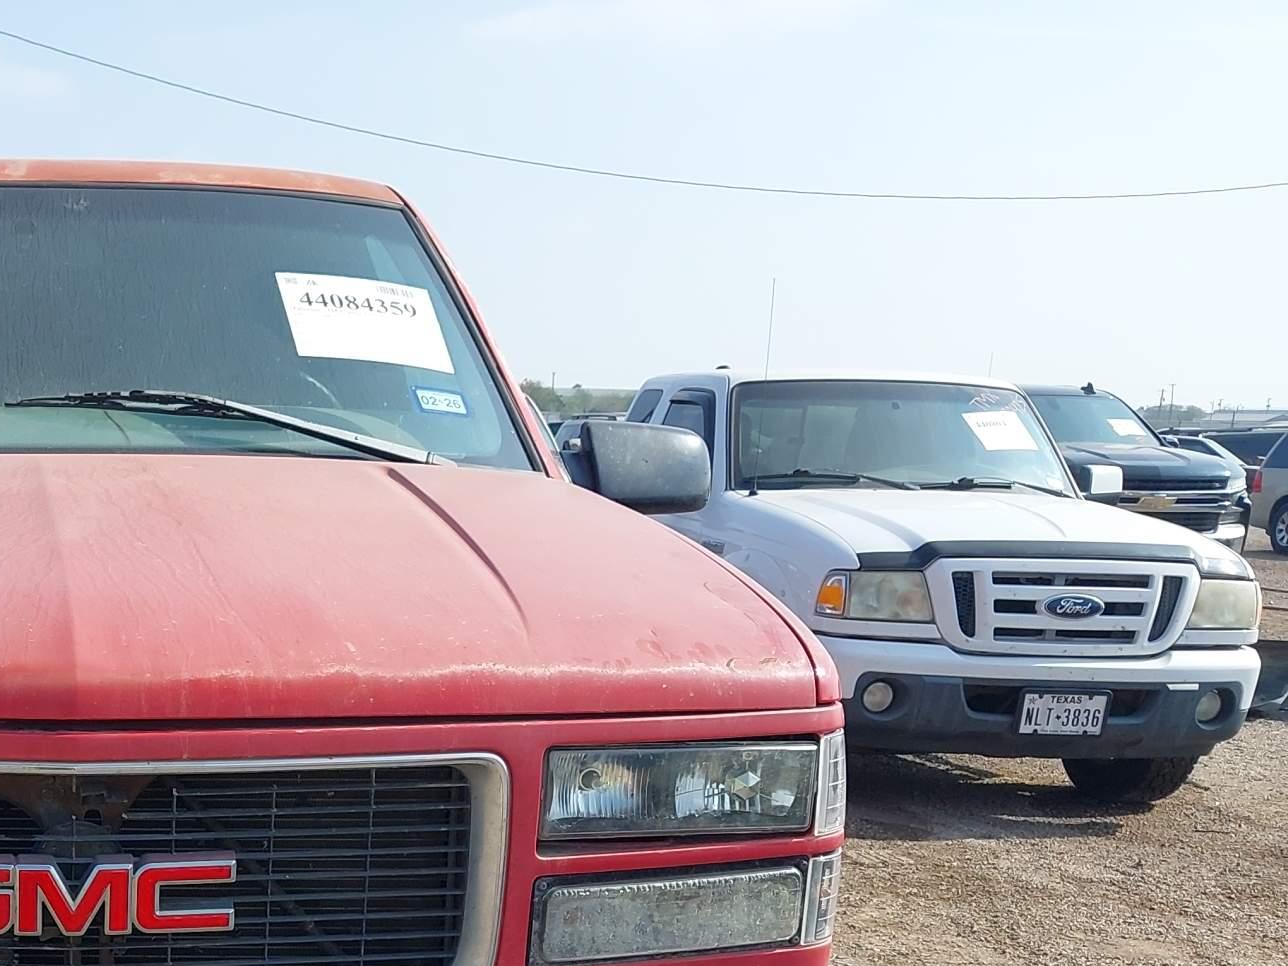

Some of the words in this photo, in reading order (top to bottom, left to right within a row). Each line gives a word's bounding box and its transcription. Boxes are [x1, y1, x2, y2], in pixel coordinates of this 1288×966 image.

[298, 291, 418, 318] 44084359
[420, 394, 462, 410] 02-26
[1056, 597, 1092, 614] Ford
[1050, 695, 1083, 705] TEXAS
